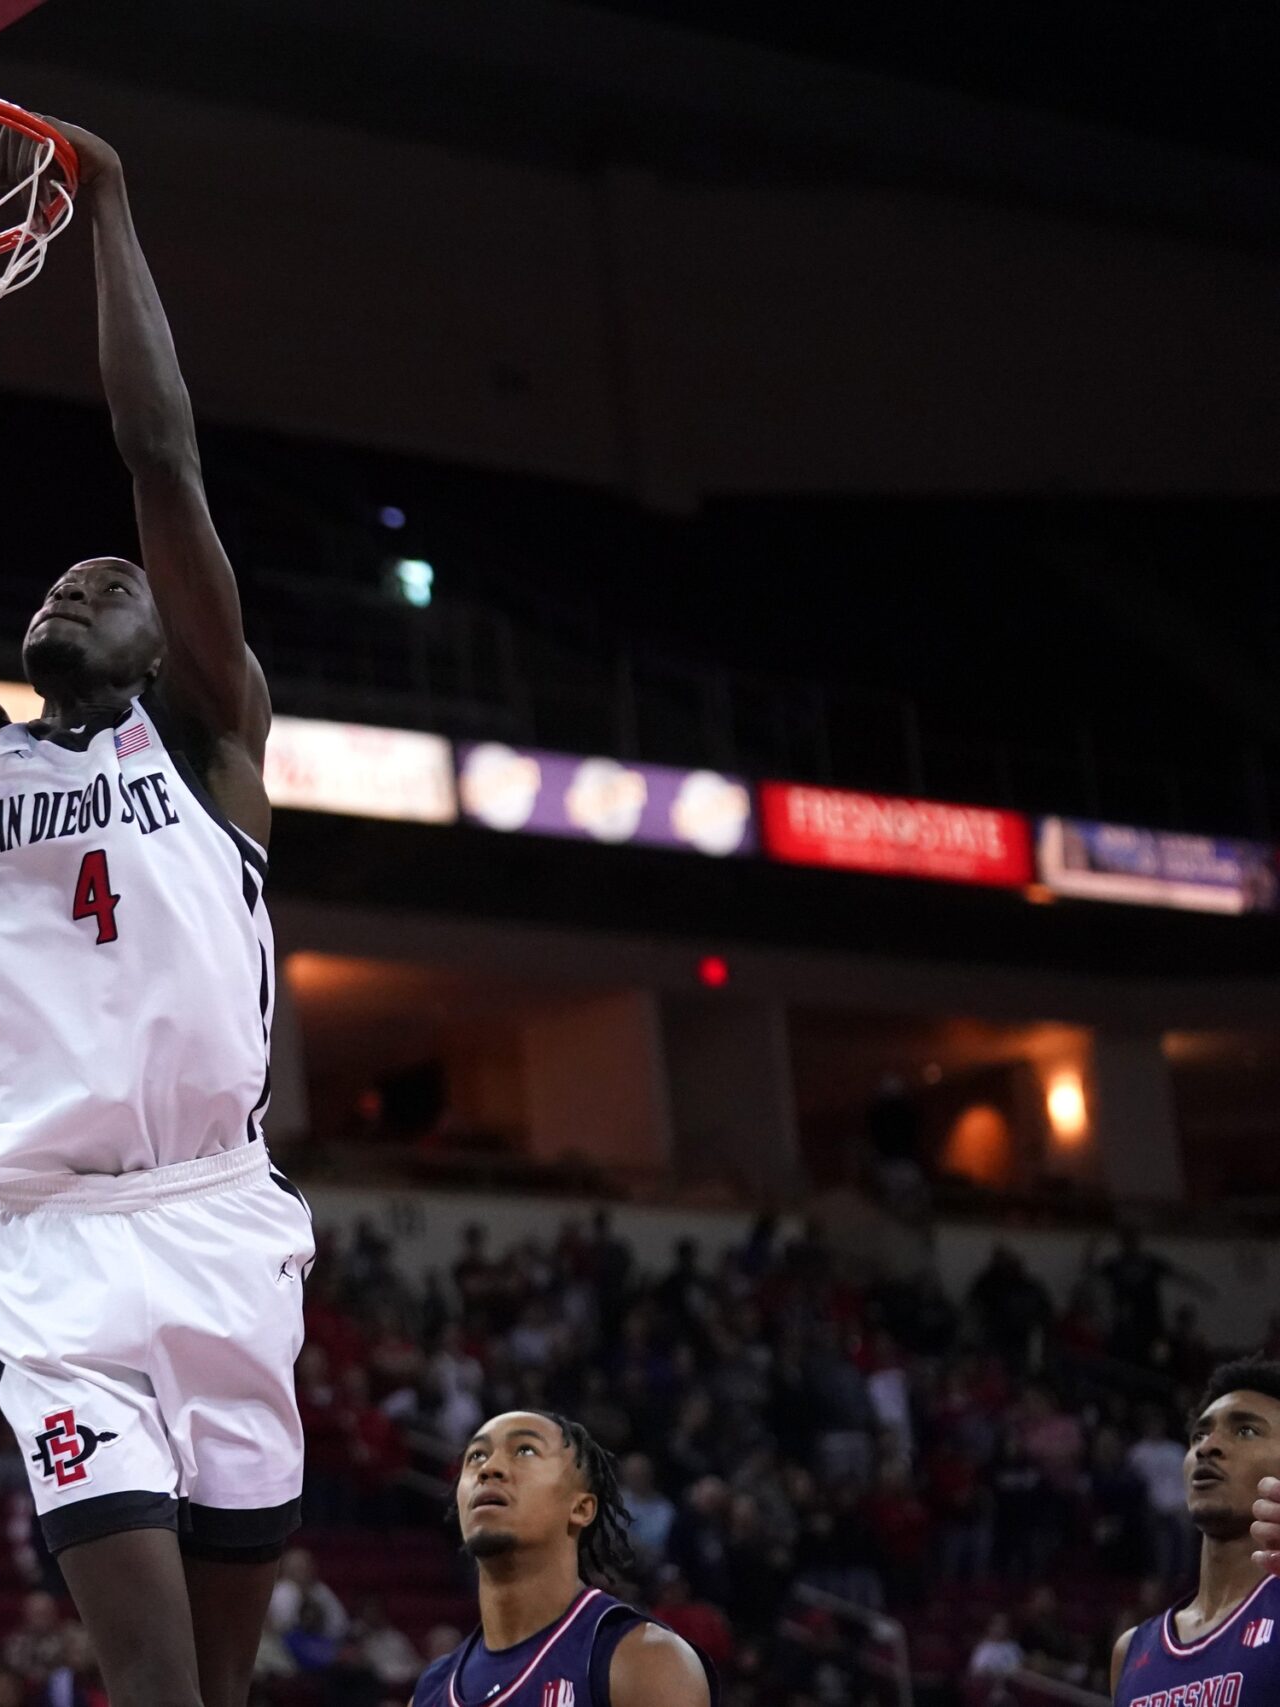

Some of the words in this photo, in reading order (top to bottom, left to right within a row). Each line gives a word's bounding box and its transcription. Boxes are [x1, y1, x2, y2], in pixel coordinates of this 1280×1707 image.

[28, 772, 112, 846] DIEGO
[118, 771, 181, 835] STE
[72, 848, 121, 945] 4
[1129, 1671, 1244, 1707] ESNO
